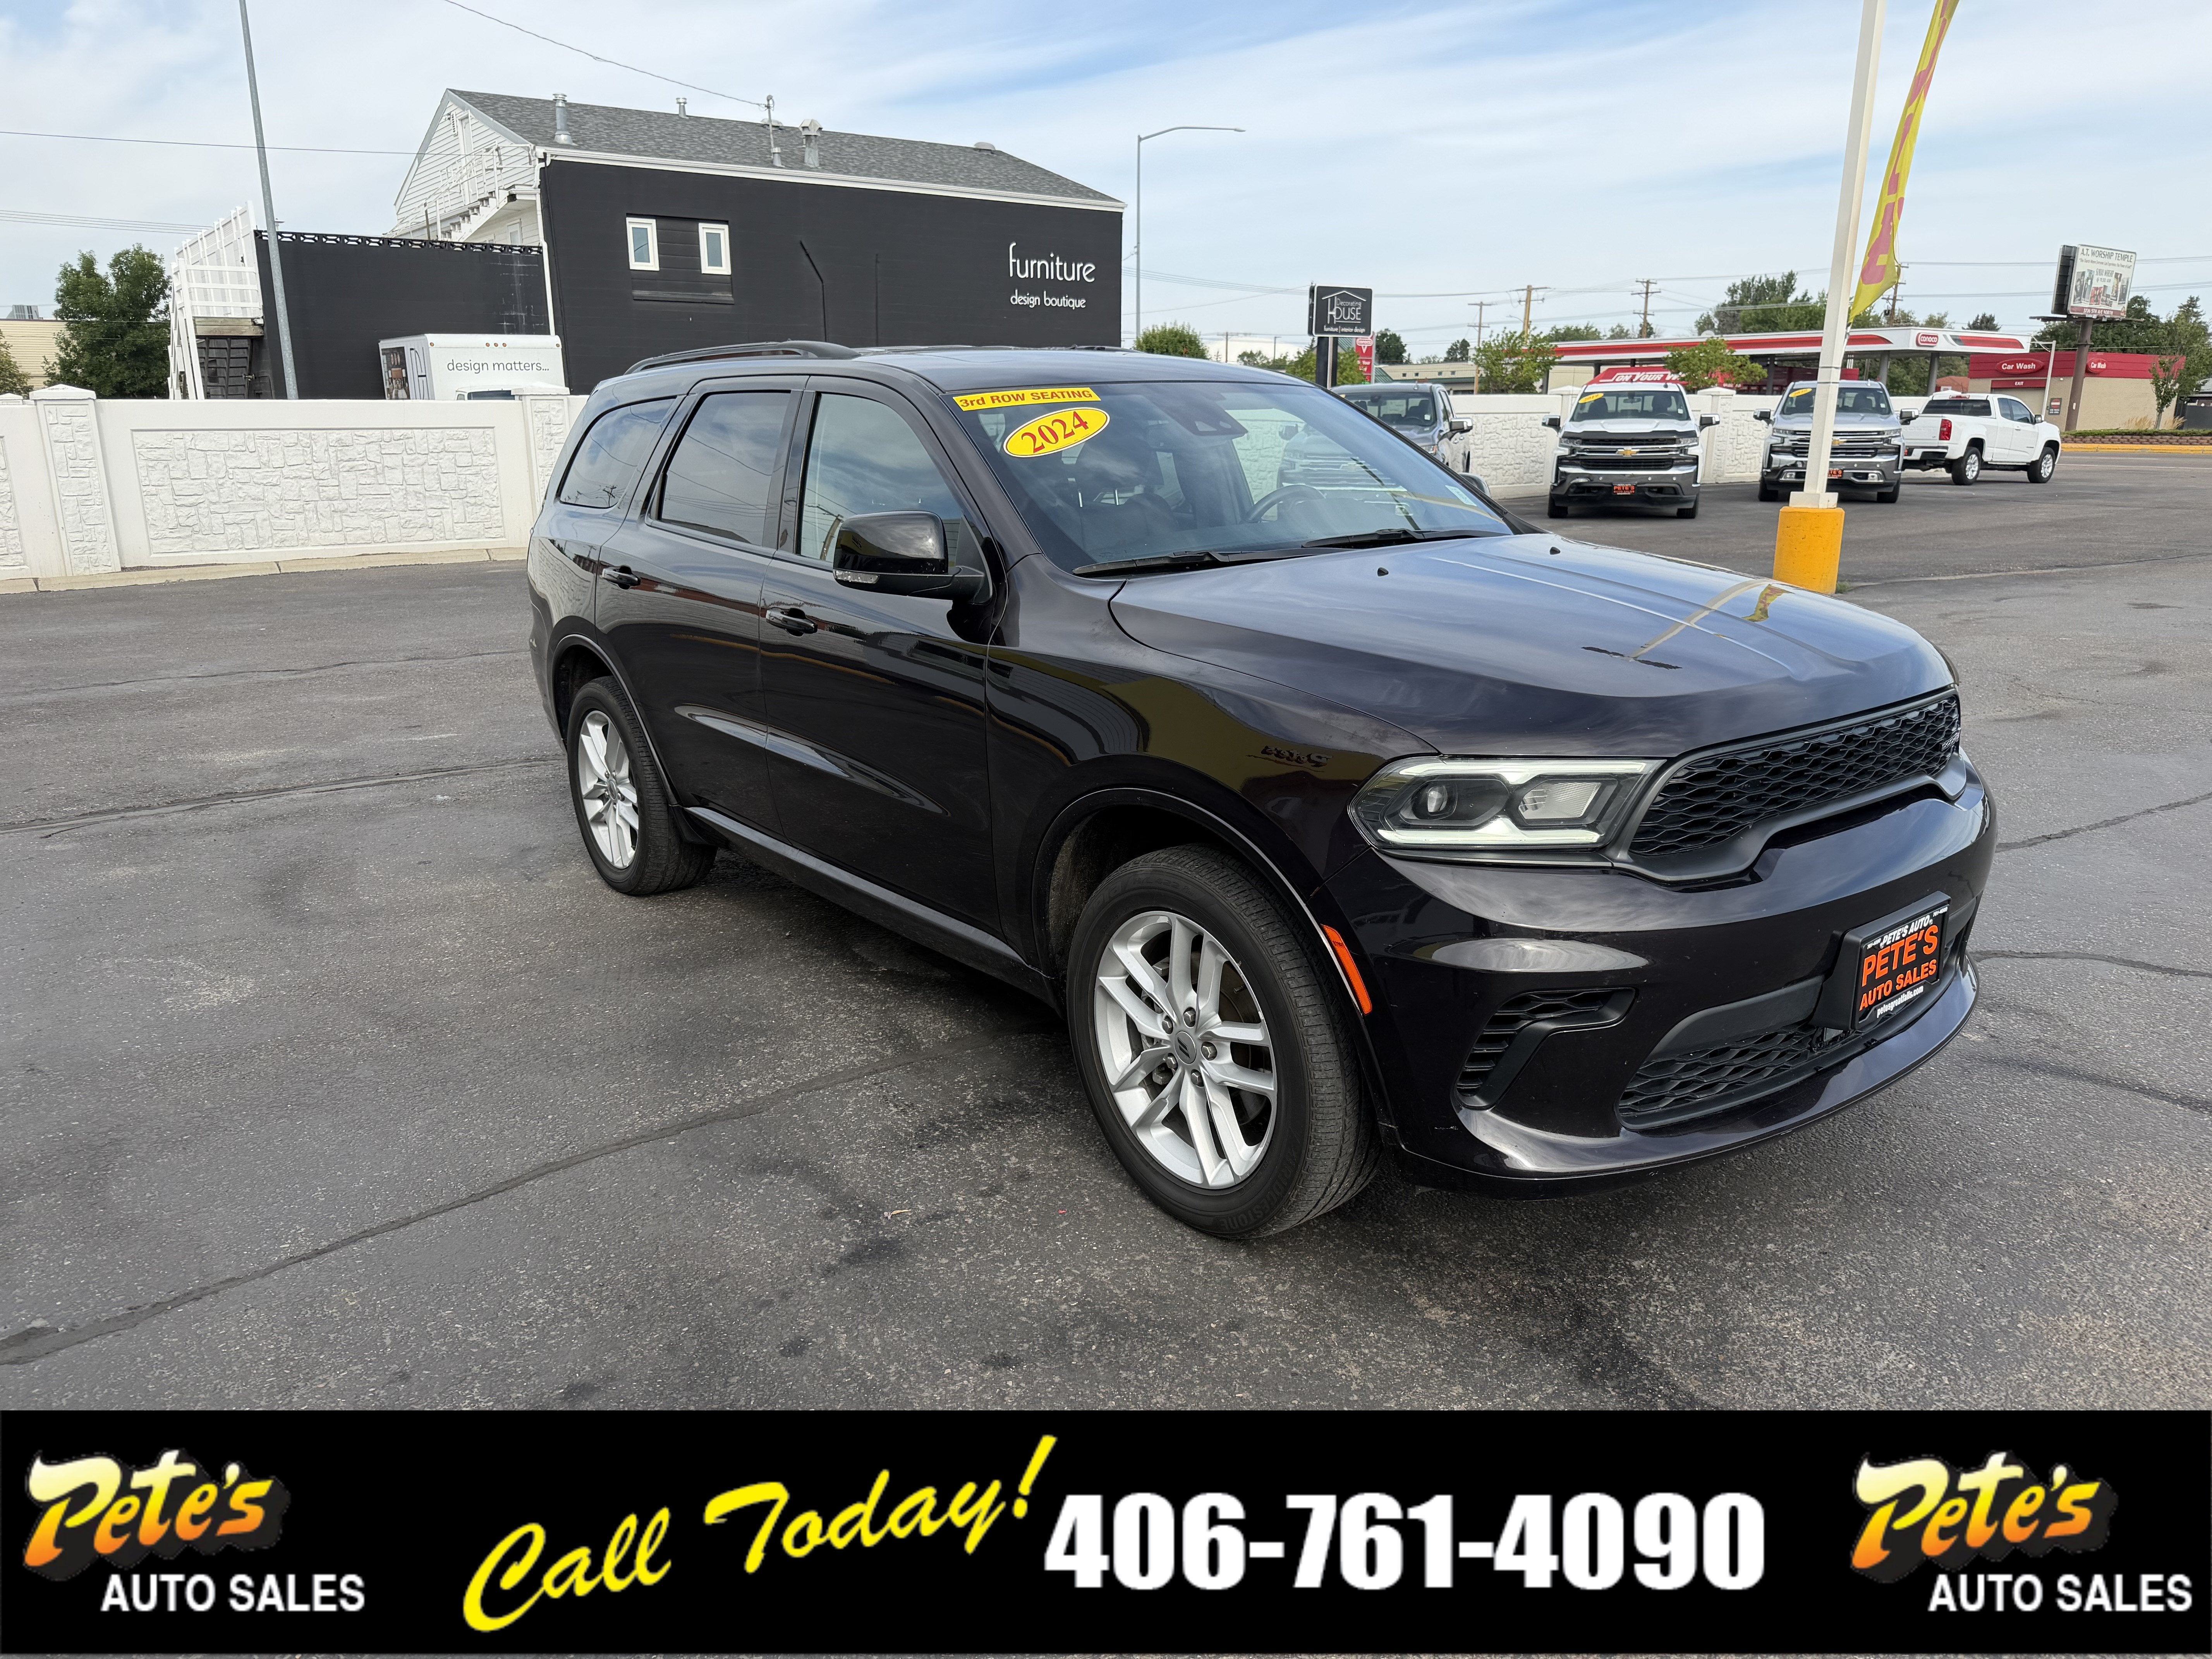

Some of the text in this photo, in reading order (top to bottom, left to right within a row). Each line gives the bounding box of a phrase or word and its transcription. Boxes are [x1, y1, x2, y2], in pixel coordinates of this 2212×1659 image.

[1009, 242, 1096, 283] furniture
[2081, 248, 2133, 263] A.T. WORSHIP TEMPLE
[1010, 289, 1086, 310] design boutique
[1327, 296, 1362, 325] HOUSE
[1336, 298, 1362, 308] Decorating
[447, 359, 549, 374] design matters...
[960, 390, 1092, 407] 3rd ROW SEATING
[1021, 410, 1089, 454] 2024
[1882, 915, 1930, 946] PETE'S AUTO
[1862, 924, 1939, 987] PETE'S
[1859, 959, 1937, 1011] AUTO SALES
[1876, 985, 1923, 1018] petesgreatfalls.com
